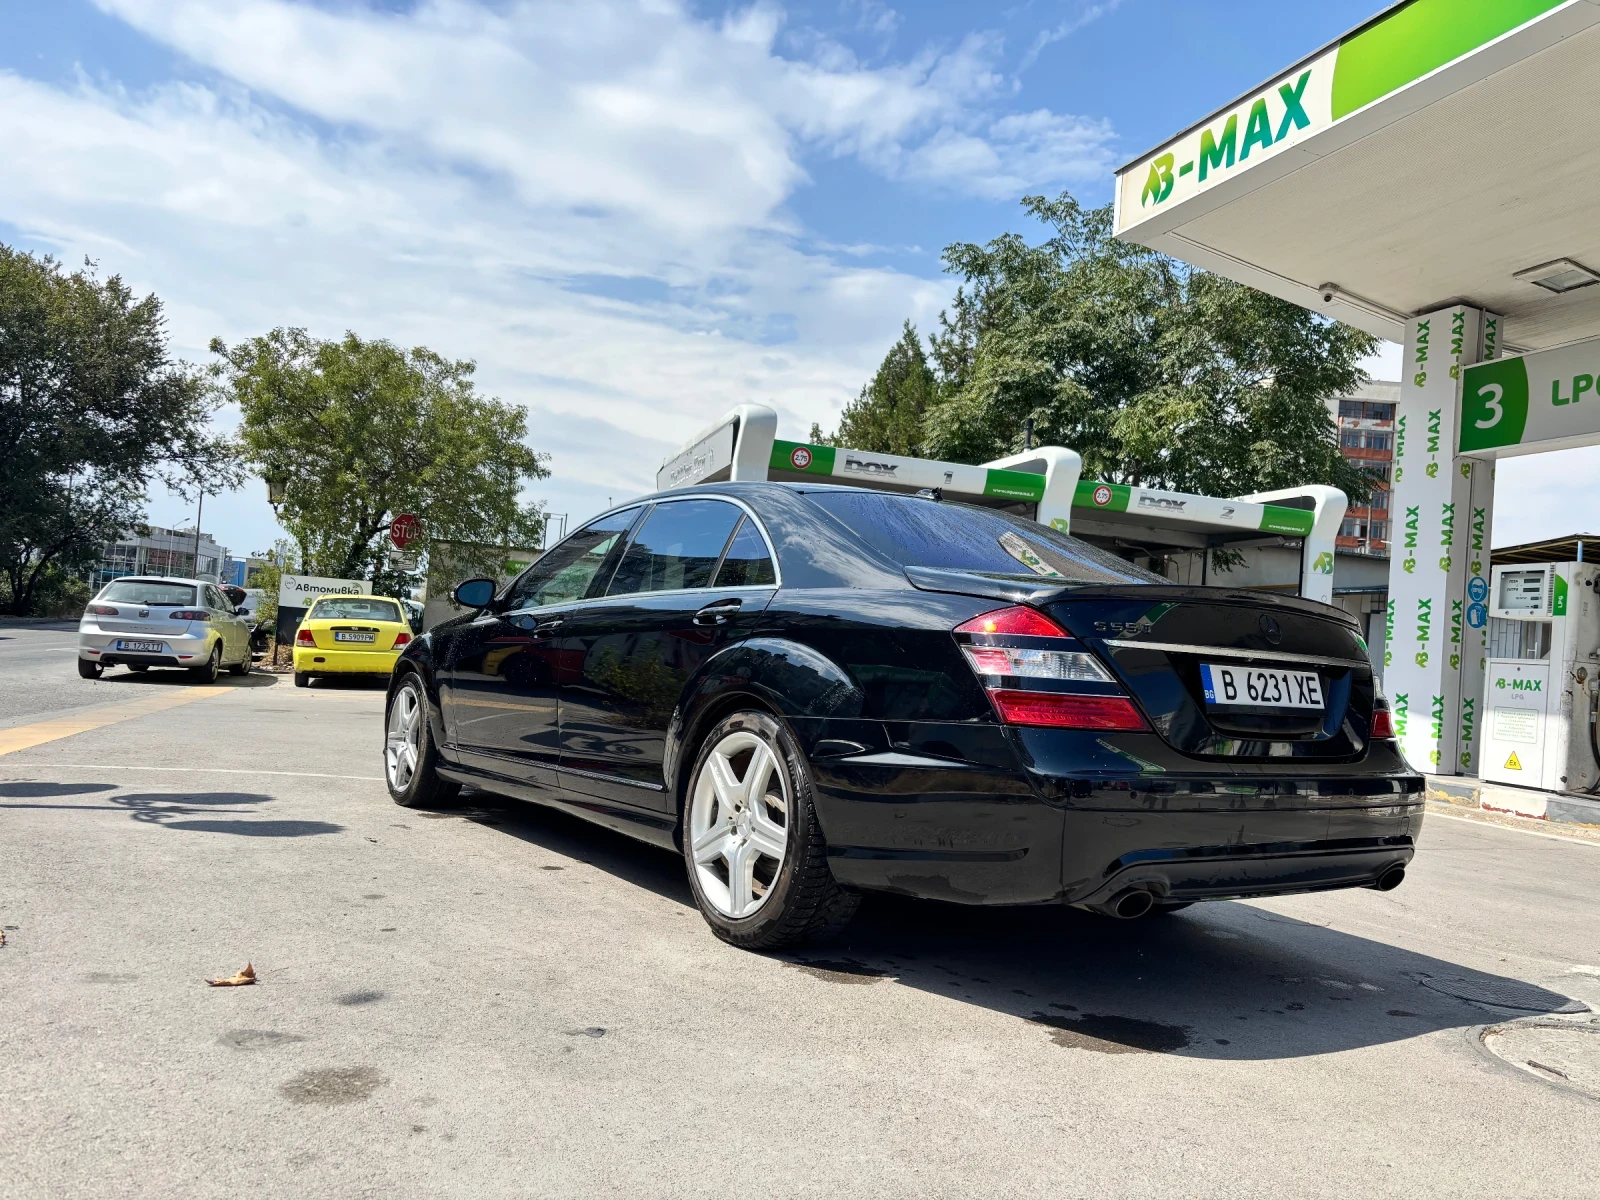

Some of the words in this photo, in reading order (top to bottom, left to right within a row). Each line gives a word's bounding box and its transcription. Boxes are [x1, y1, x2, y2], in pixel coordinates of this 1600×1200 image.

[1484, 318, 1497, 360] MAX
[1552, 374, 1600, 406] LP
[1474, 383, 1503, 429] 3
[795, 454, 808, 462] 2.75
[844, 455, 899, 478] box
[944, 471, 953, 484] 1
[1138, 492, 1187, 513] box
[1220, 506, 1235, 519] 2
[295, 584, 360, 595] Автомивка
[1204, 689, 1215, 699] BG
[1221, 670, 1237, 700] B
[1395, 693, 1409, 754] -MAX
